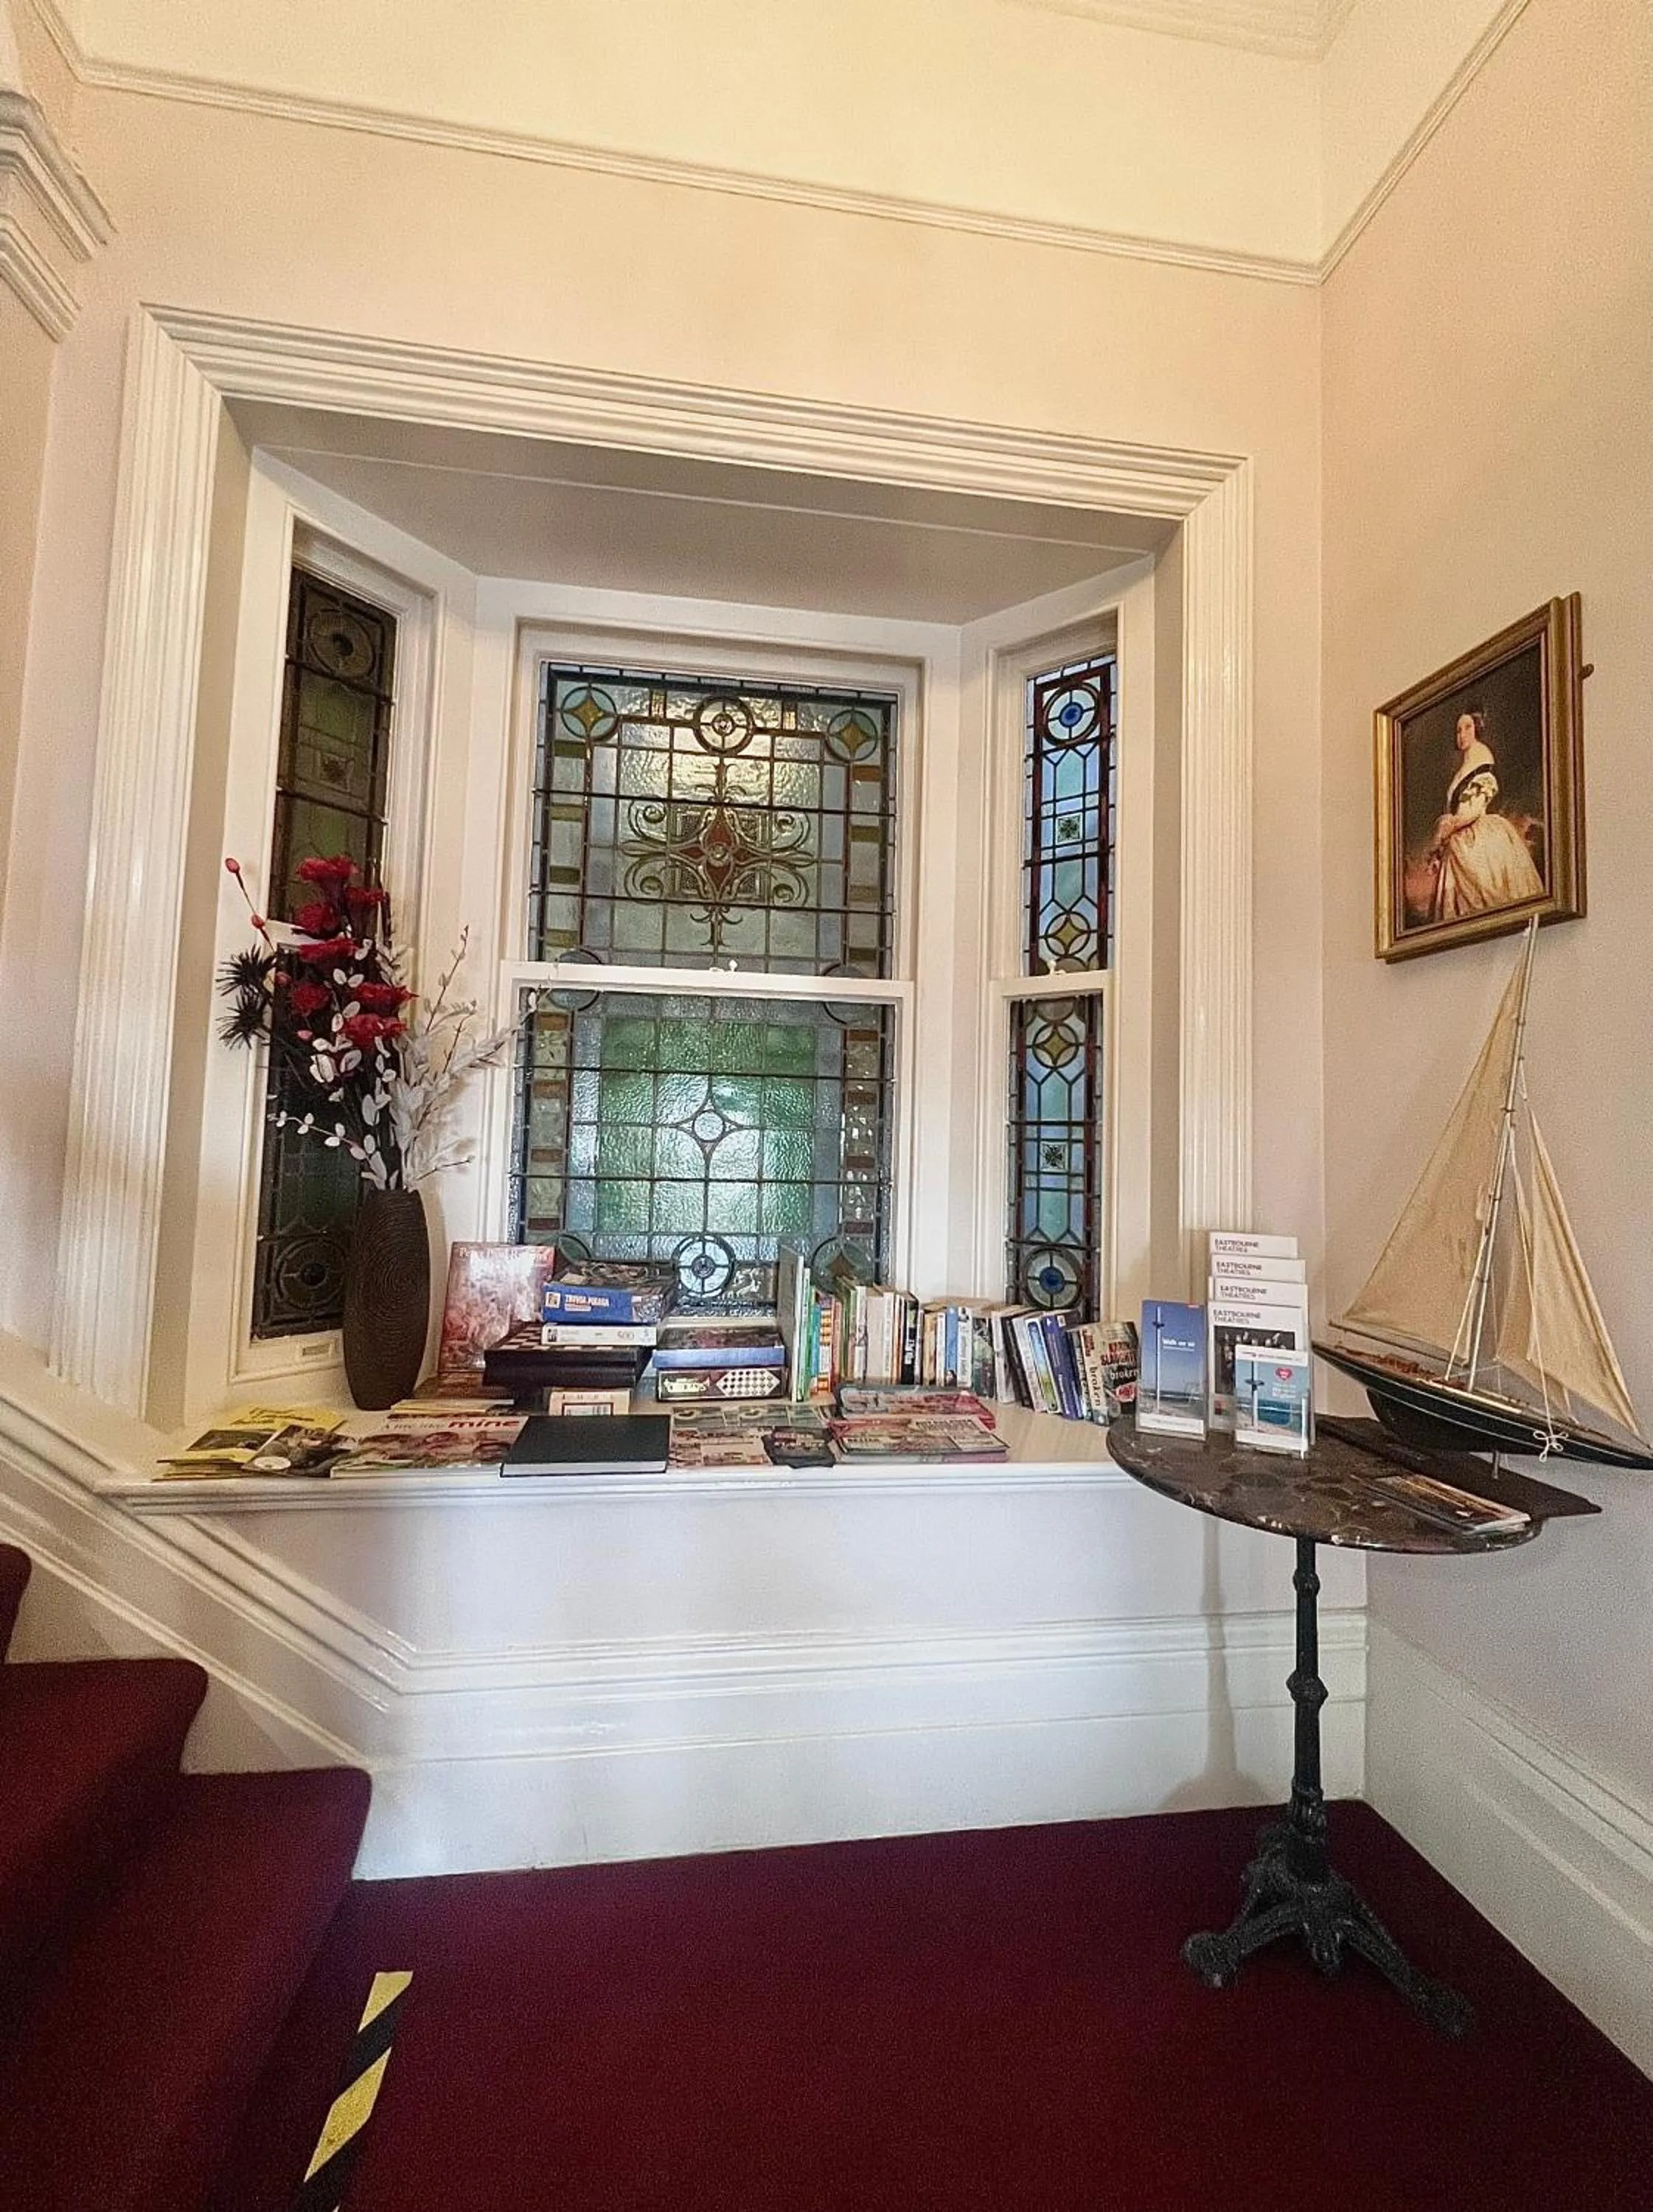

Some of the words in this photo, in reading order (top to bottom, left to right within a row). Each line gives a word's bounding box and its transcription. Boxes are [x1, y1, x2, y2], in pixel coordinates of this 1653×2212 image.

[1214, 1239, 1259, 1248] EASTBOURNE
[1217, 1262, 1262, 1270] EASTBOURNE
[1220, 1285, 1267, 1294] EASTBOURNE
[1213, 1310, 1261, 1319] EASTBOURNE
[1090, 1366, 1101, 1406] broken
[448, 1418, 520, 1429] mine
